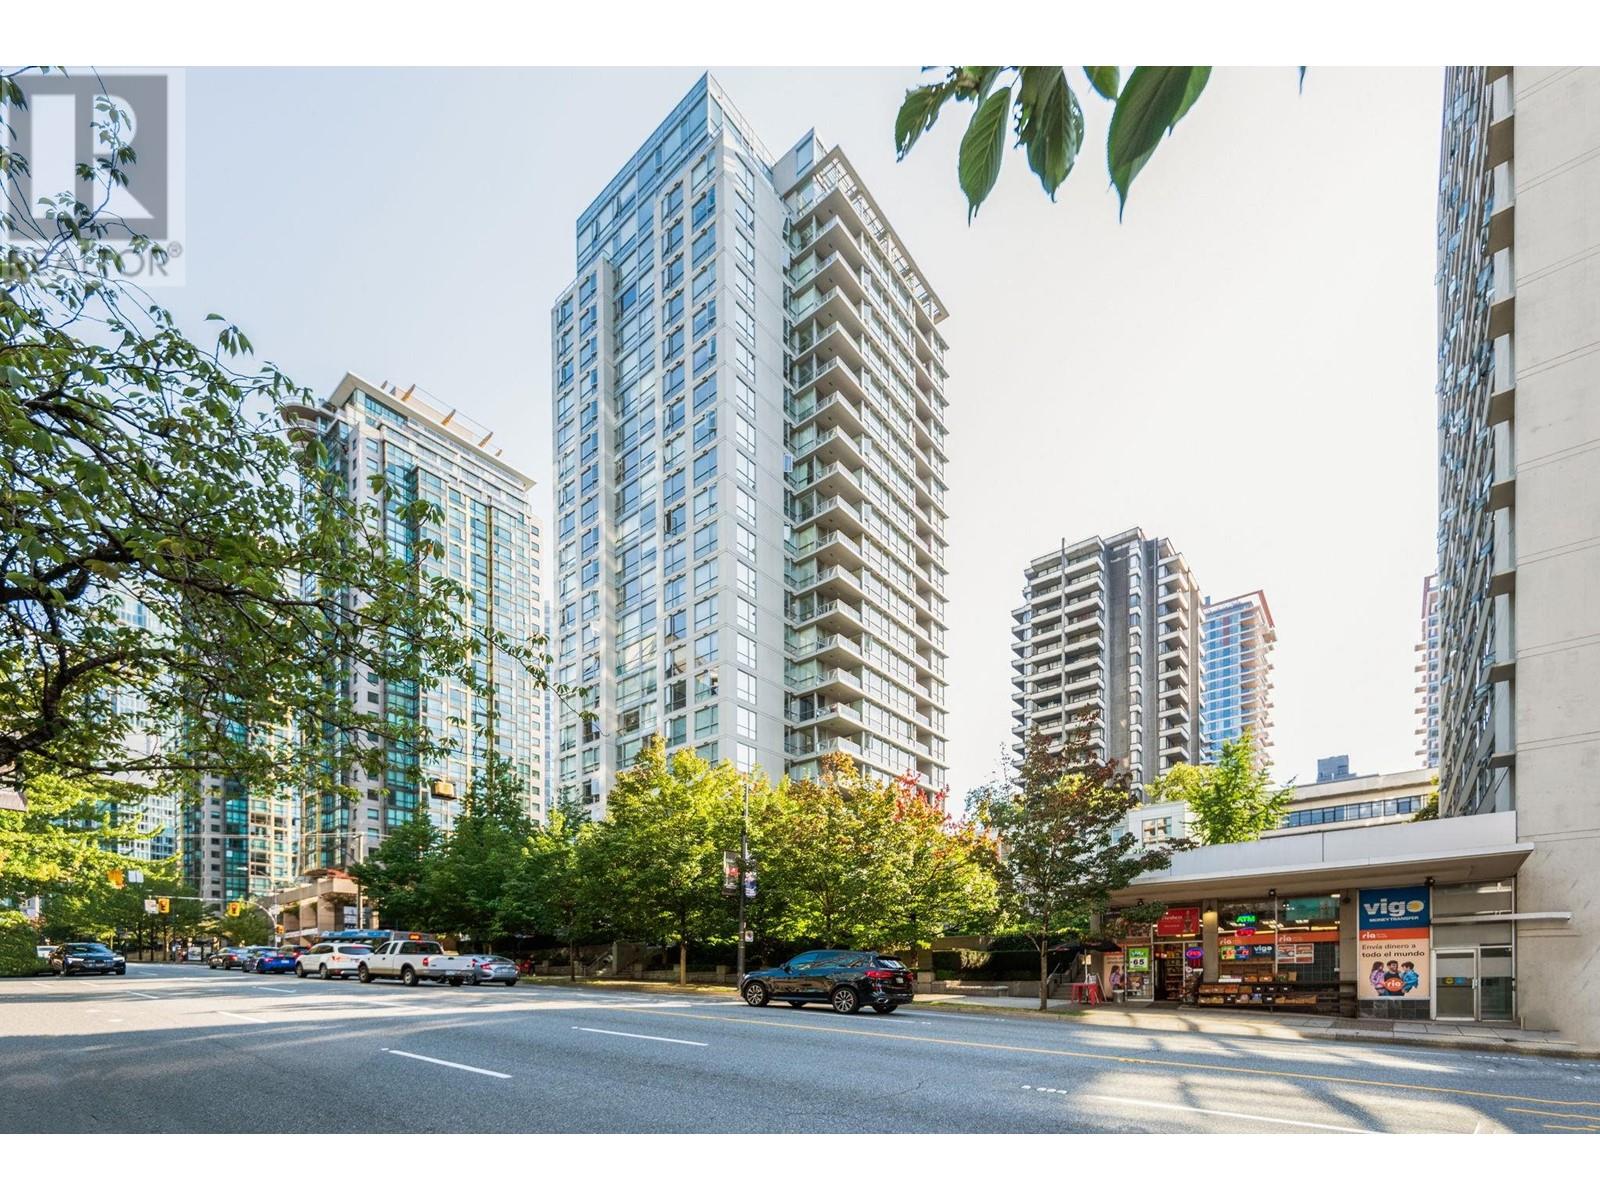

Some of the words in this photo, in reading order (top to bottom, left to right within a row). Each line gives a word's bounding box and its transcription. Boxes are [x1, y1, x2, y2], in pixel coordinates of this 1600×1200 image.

[1363, 898, 1425, 917] vigo
[1236, 915, 1256, 923] ATM
[1362, 931, 1376, 939] ria
[1387, 979, 1401, 987] ria
